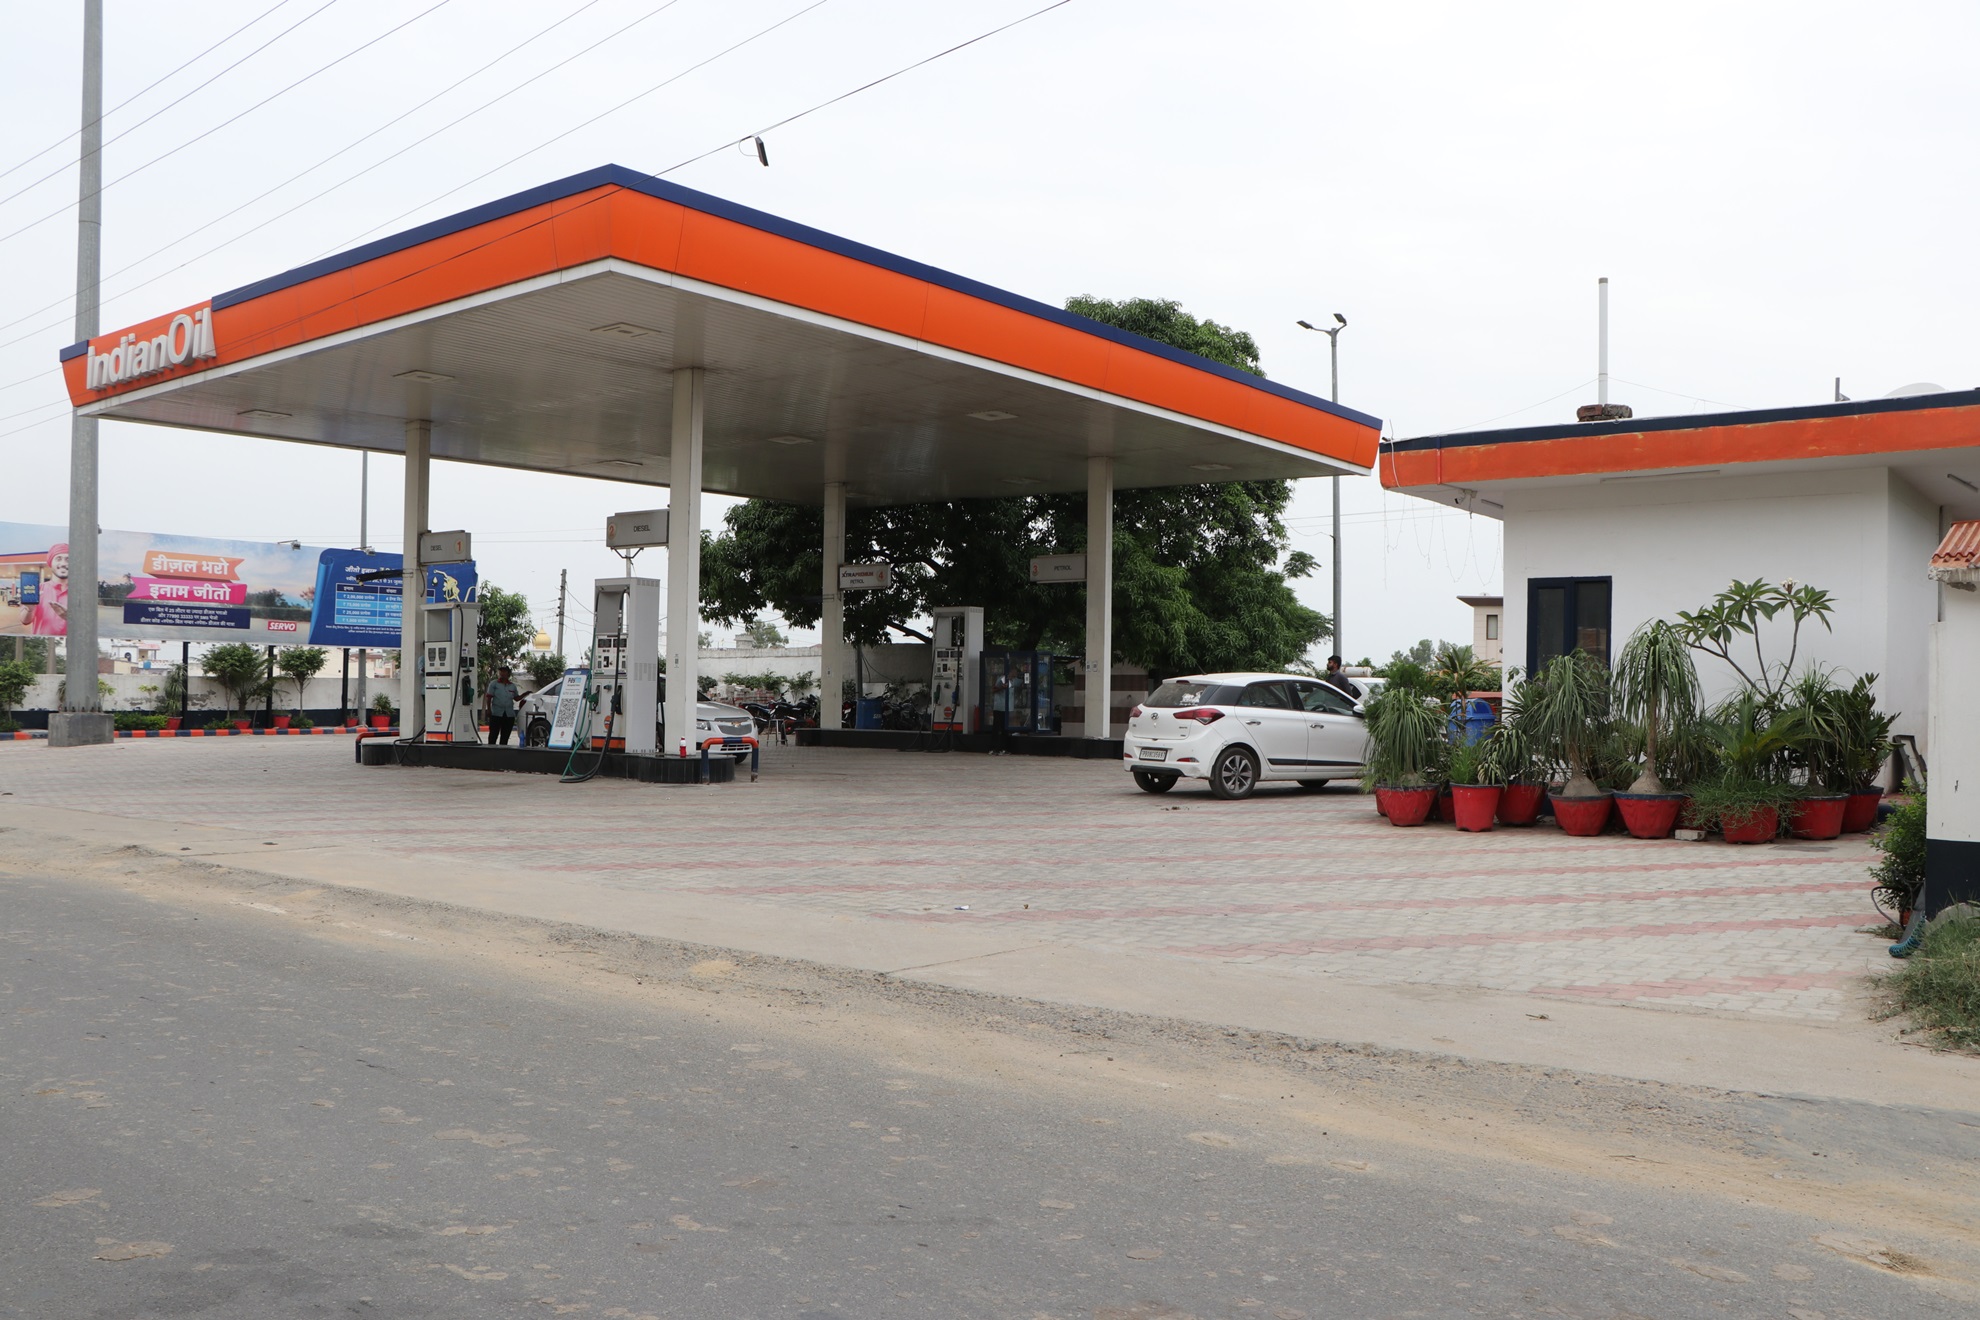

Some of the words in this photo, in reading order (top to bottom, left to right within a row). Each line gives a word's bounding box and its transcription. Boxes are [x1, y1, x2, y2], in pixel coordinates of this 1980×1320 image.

[86, 307, 215, 391] IndianOil
[152, 554, 198, 573] डीज़ल
[202, 558, 229, 575] भरो
[149, 583, 189, 599] इनाम
[193, 582, 231, 600] जीतो
[269, 622, 296, 631] SERVO
